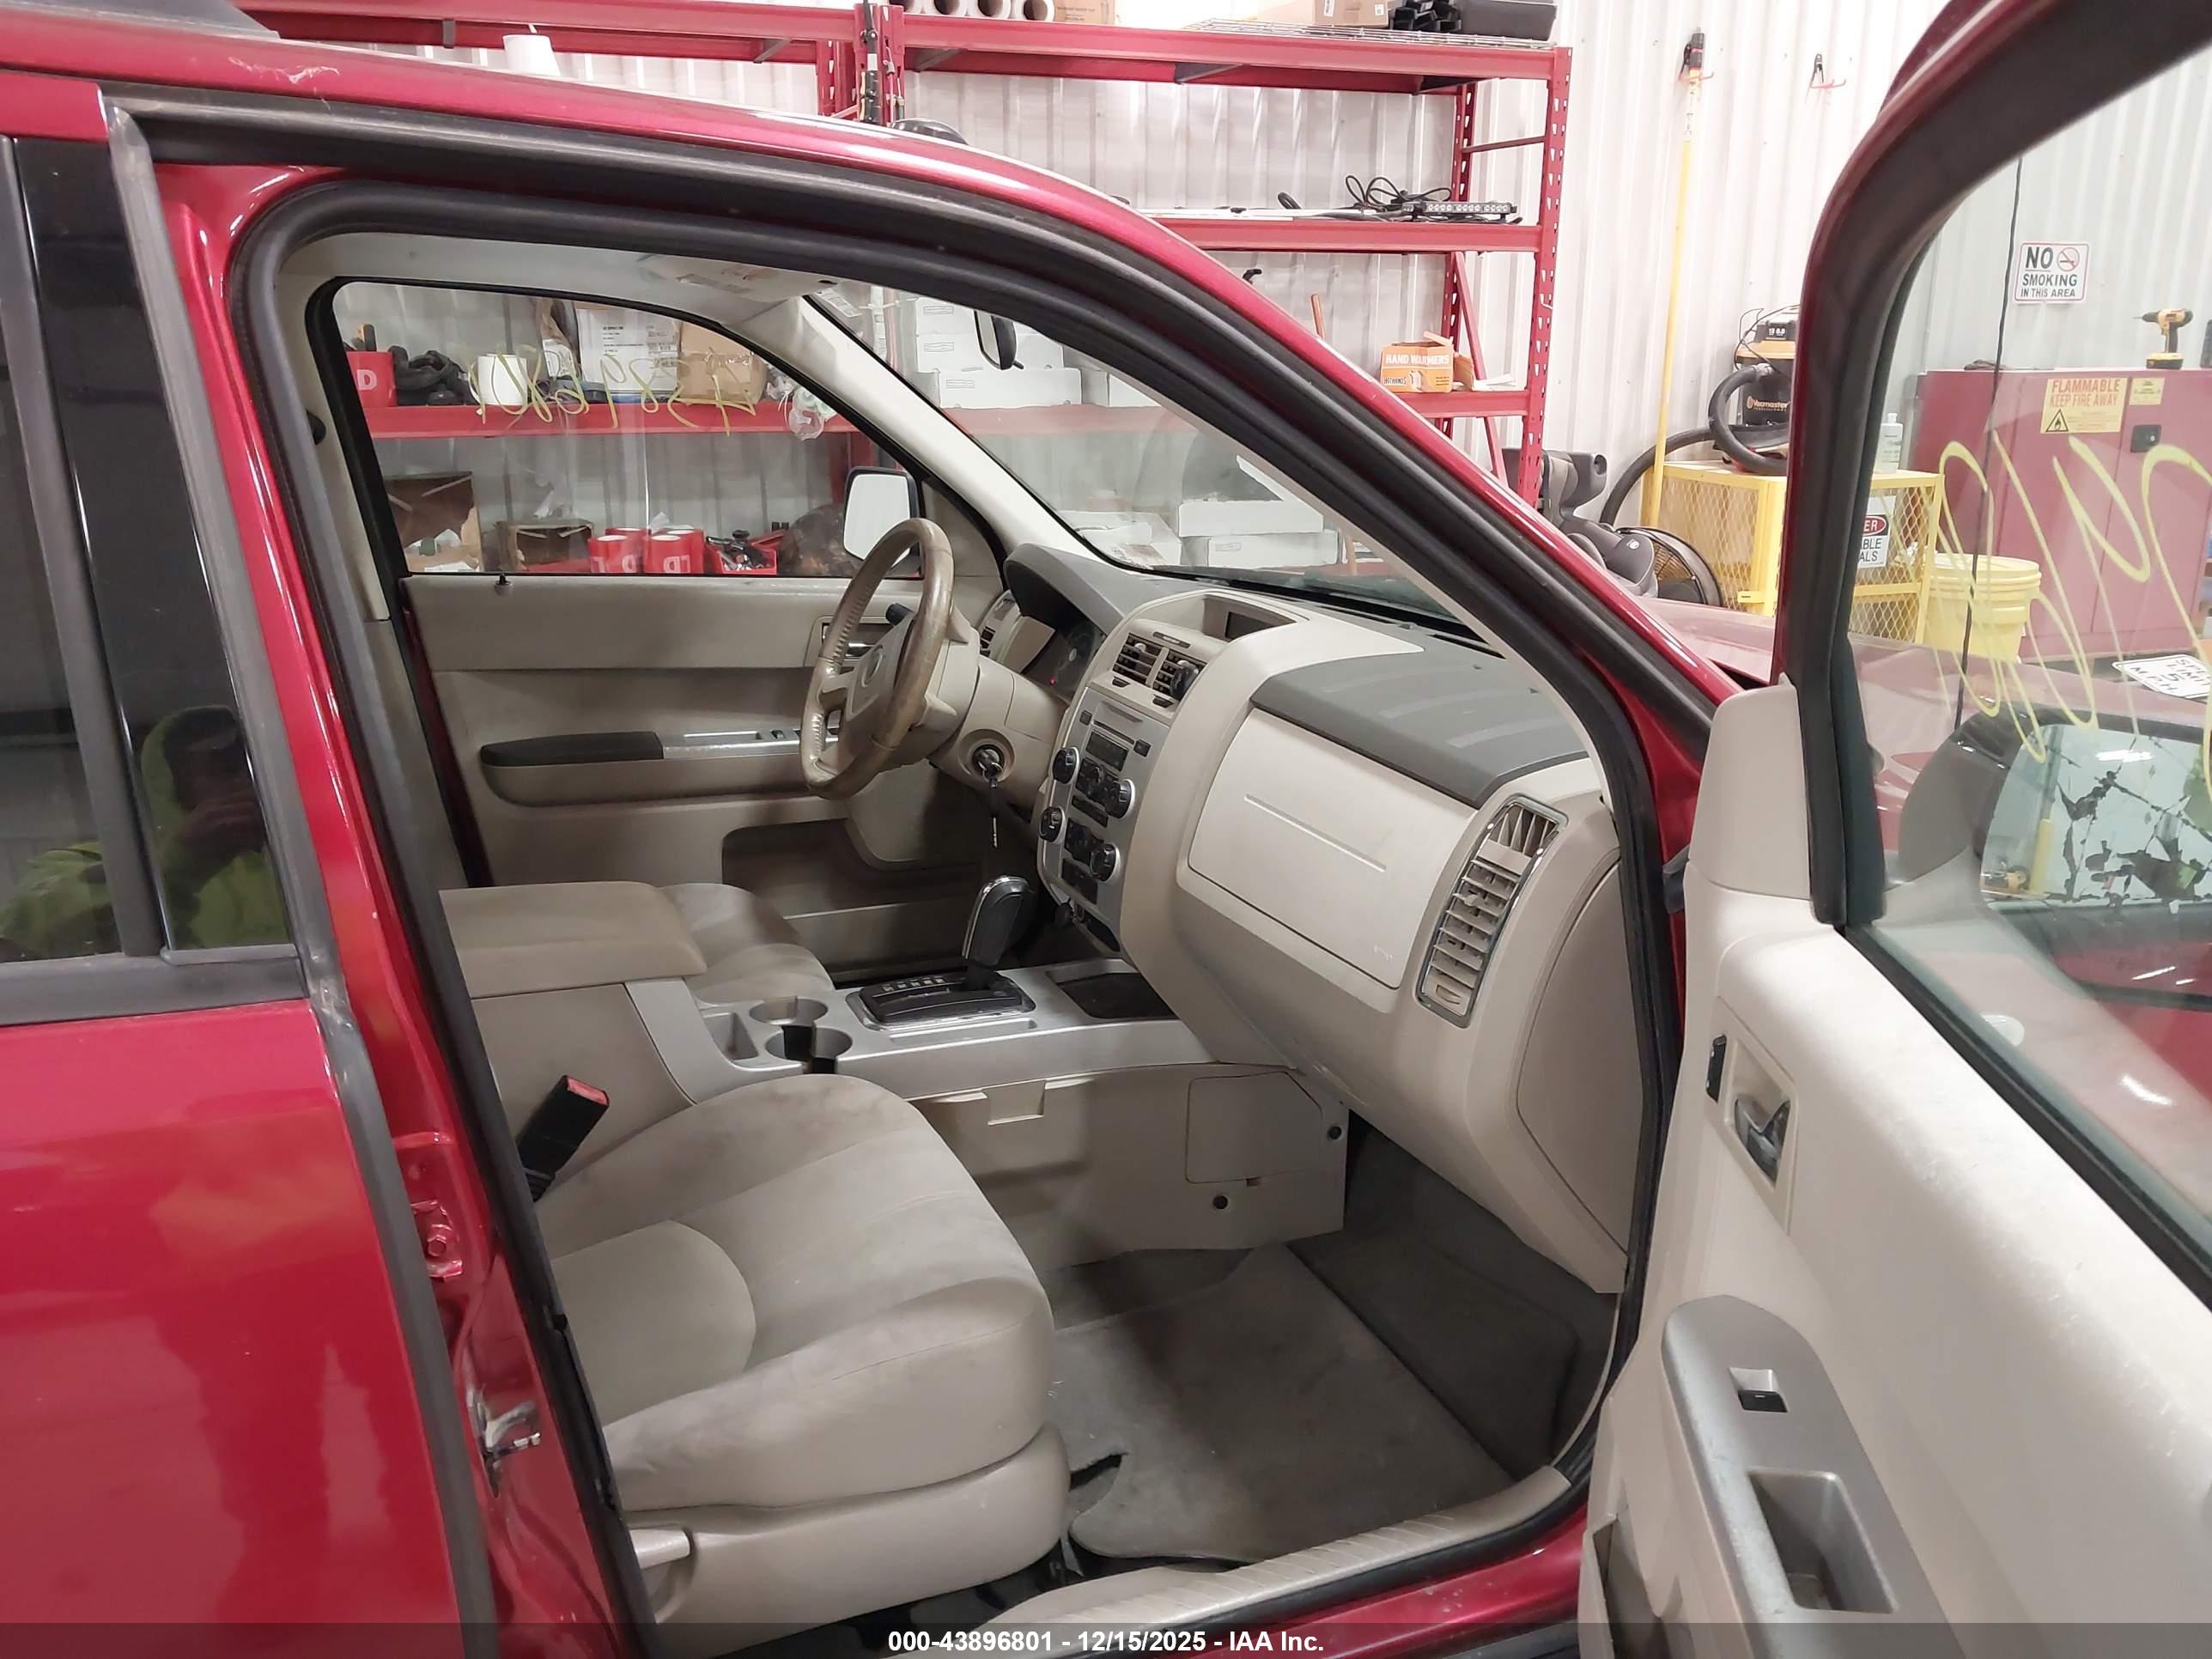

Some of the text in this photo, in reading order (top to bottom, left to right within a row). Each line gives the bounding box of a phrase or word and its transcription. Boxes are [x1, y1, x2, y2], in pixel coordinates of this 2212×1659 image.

[2026, 246, 2054, 269] NO
[2022, 274, 2078, 287] SMOKING
[2021, 289, 2075, 298] IN THIS AREA
[1387, 354, 1449, 365] HAND WARMERS
[2052, 379, 2121, 393] FLAMMABLE
[2050, 393, 2118, 407] KEEP FIRE AWAY
